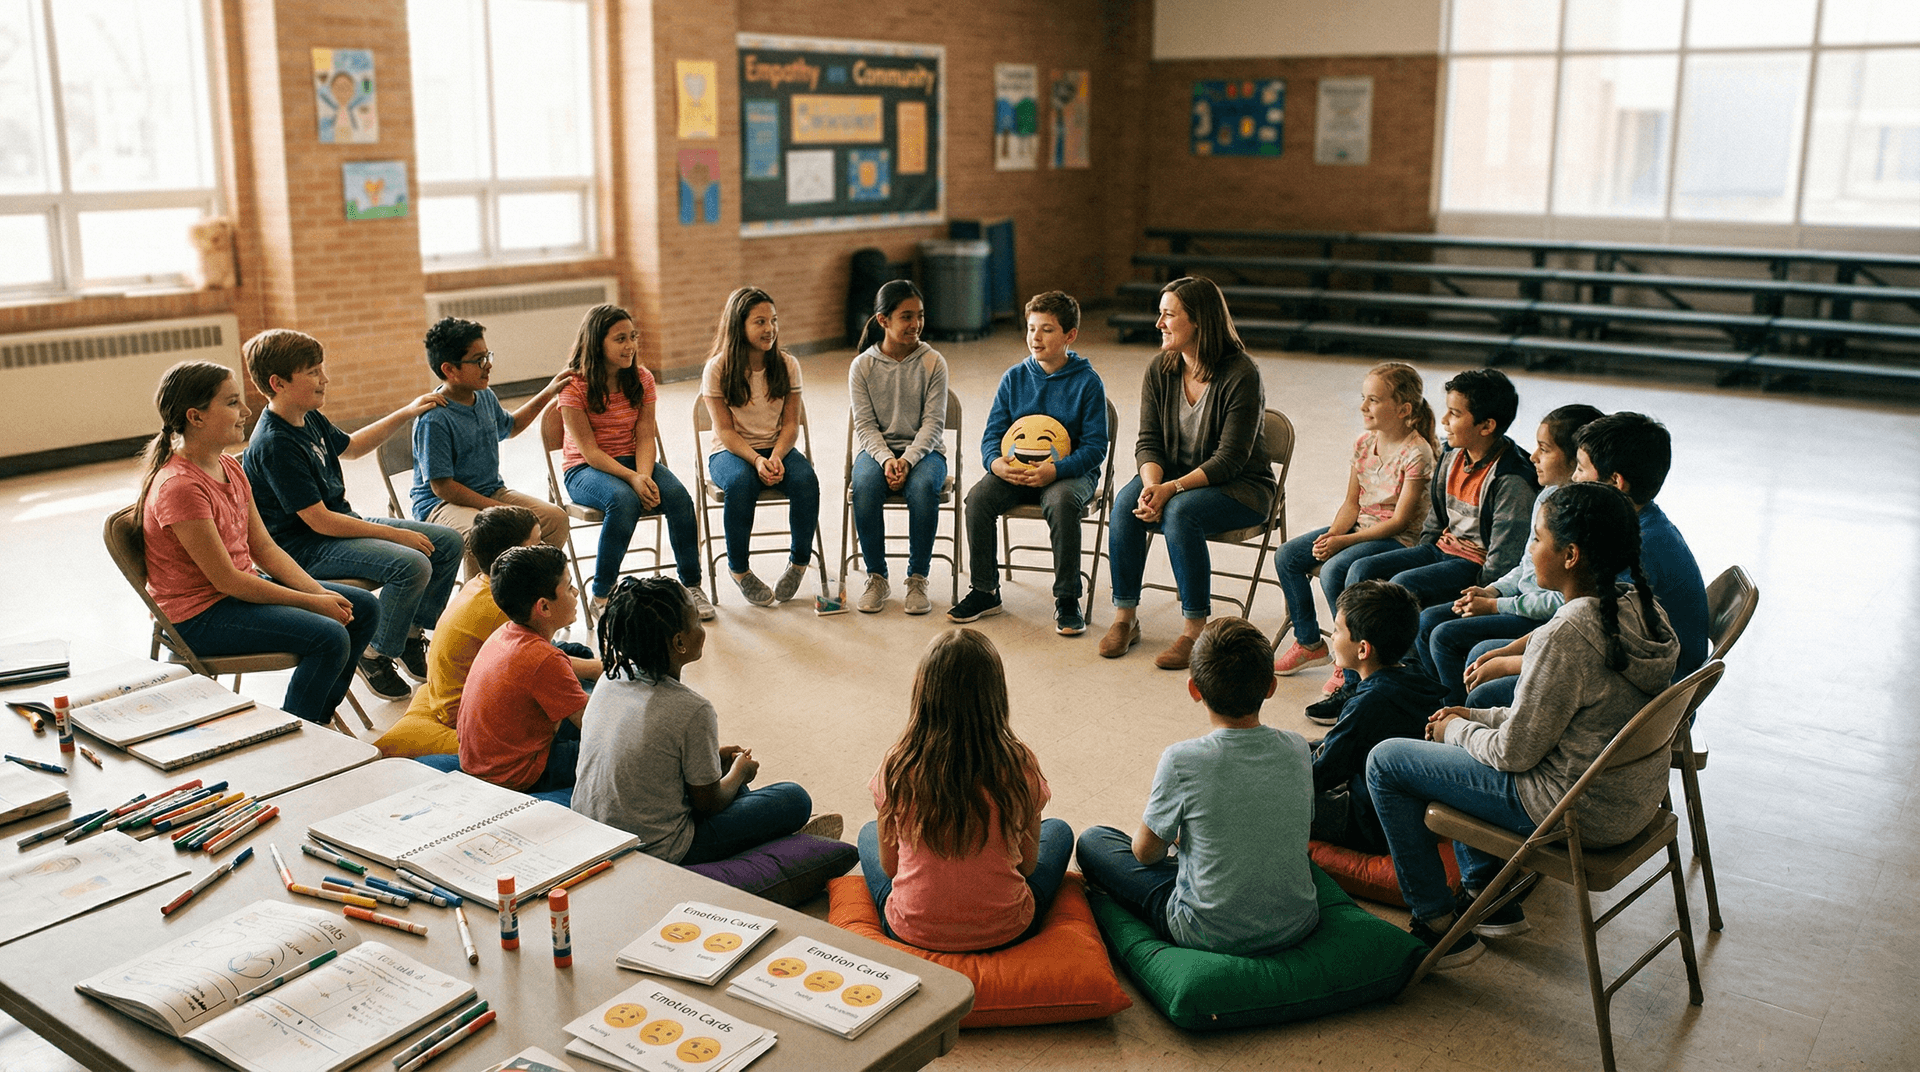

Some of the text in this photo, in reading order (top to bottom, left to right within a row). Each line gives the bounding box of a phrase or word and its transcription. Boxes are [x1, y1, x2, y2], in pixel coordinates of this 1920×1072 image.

[745, 54, 820, 91] Empathy
[852, 59, 935, 95] Community
[683, 906, 762, 931] Emotion Cards
[806, 945, 892, 981] Emotion Cards
[649, 991, 734, 1034] Emotion Cards
